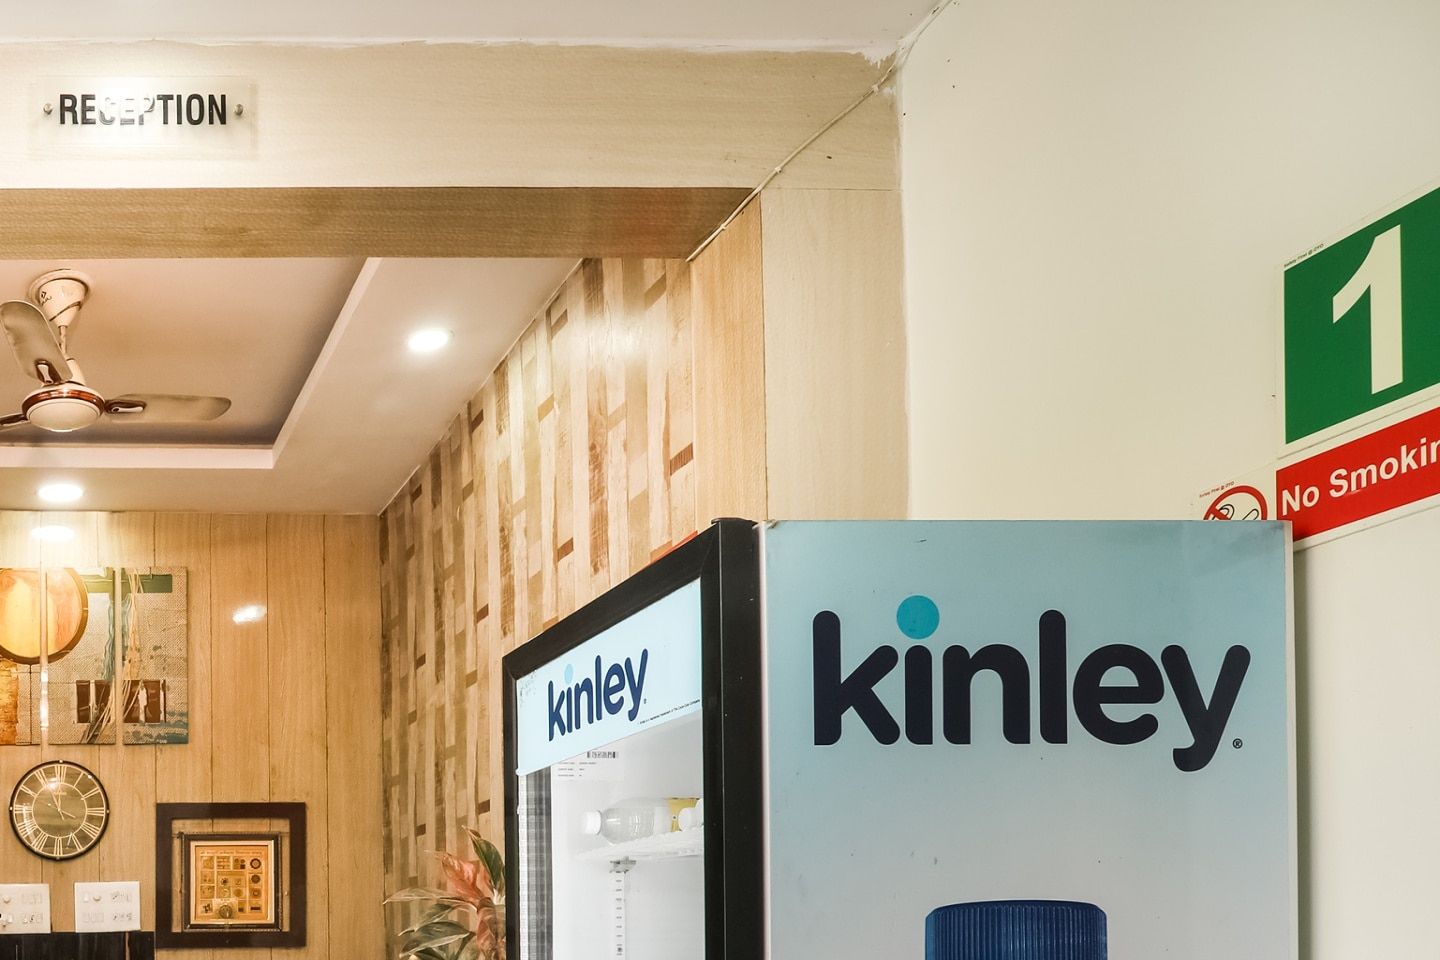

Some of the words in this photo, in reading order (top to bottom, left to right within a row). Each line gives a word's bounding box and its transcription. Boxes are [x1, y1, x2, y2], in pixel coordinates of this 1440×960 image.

[1332, 223, 1403, 395] 1
[1281, 484, 1320, 516] No
[547, 648, 649, 742] kinley
[812, 594, 1252, 773] kinley
